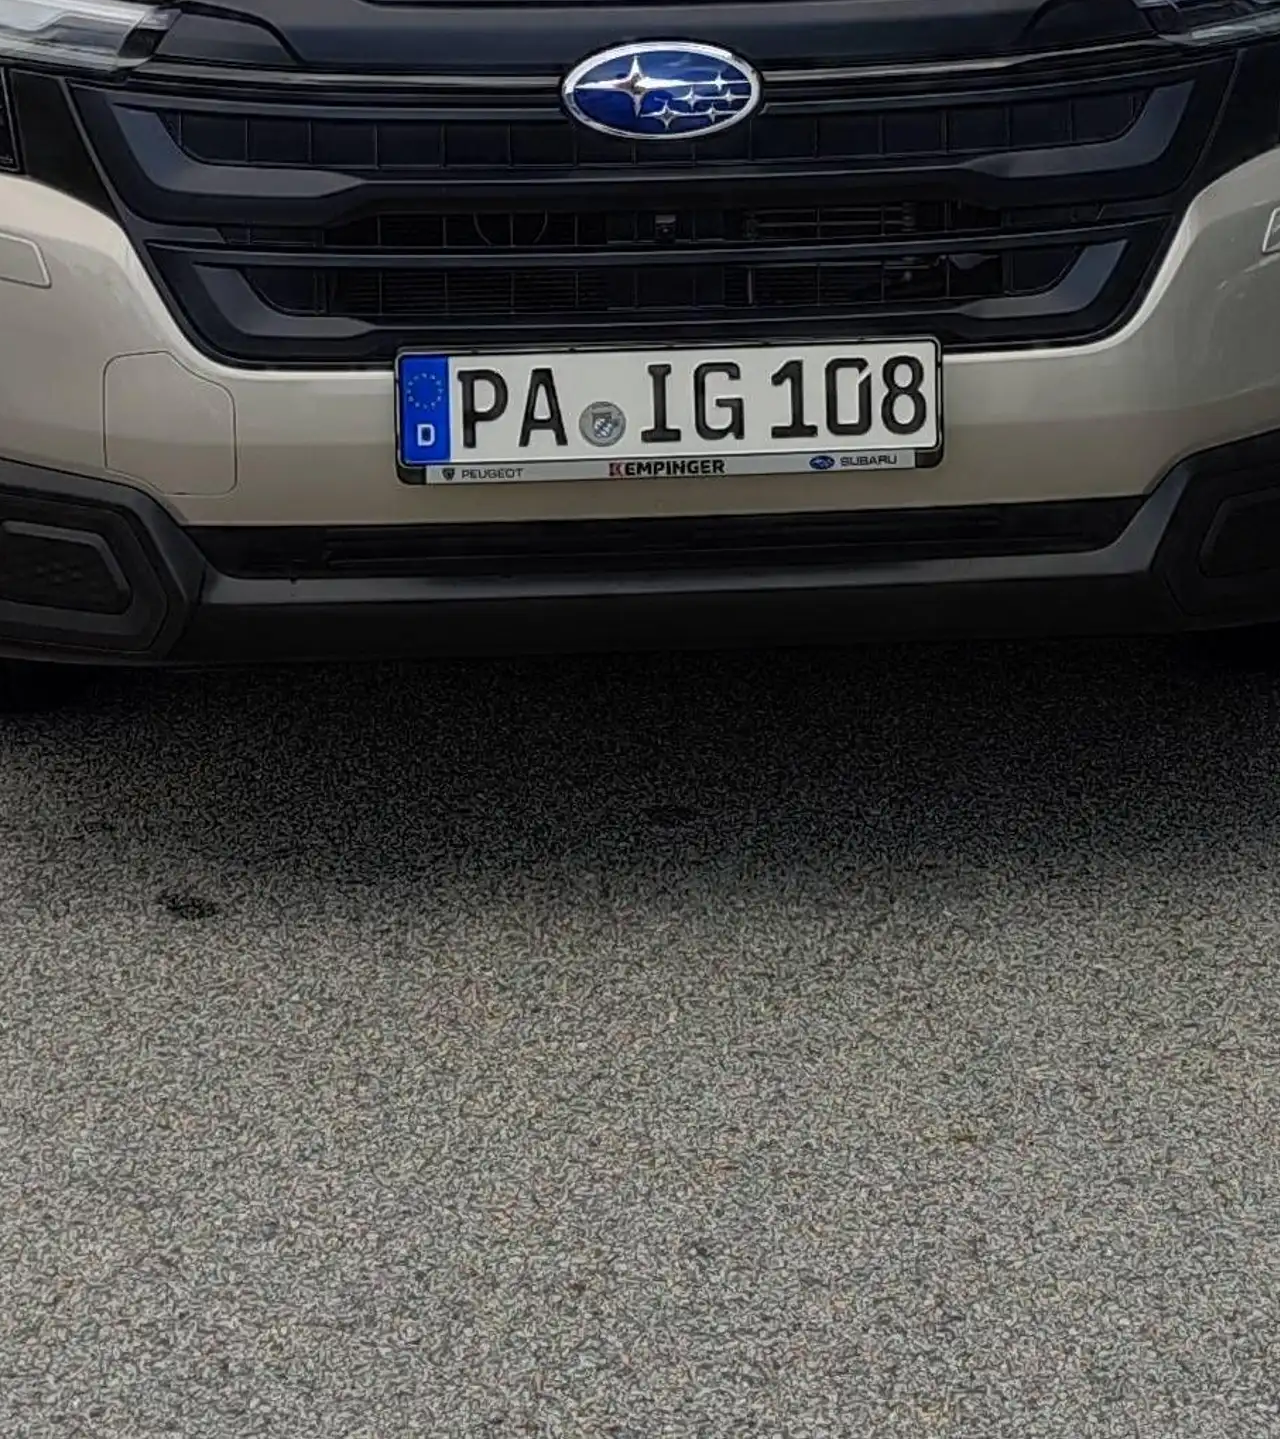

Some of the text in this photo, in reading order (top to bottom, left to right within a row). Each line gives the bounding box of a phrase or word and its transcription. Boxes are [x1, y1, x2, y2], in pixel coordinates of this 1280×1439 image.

[456, 355, 927, 449] PA IG 108
[417, 423, 436, 447] D
[609, 460, 726, 477] KEMPINGER
[839, 455, 898, 467] SUBARU
[461, 467, 524, 479] PEUGEOT
